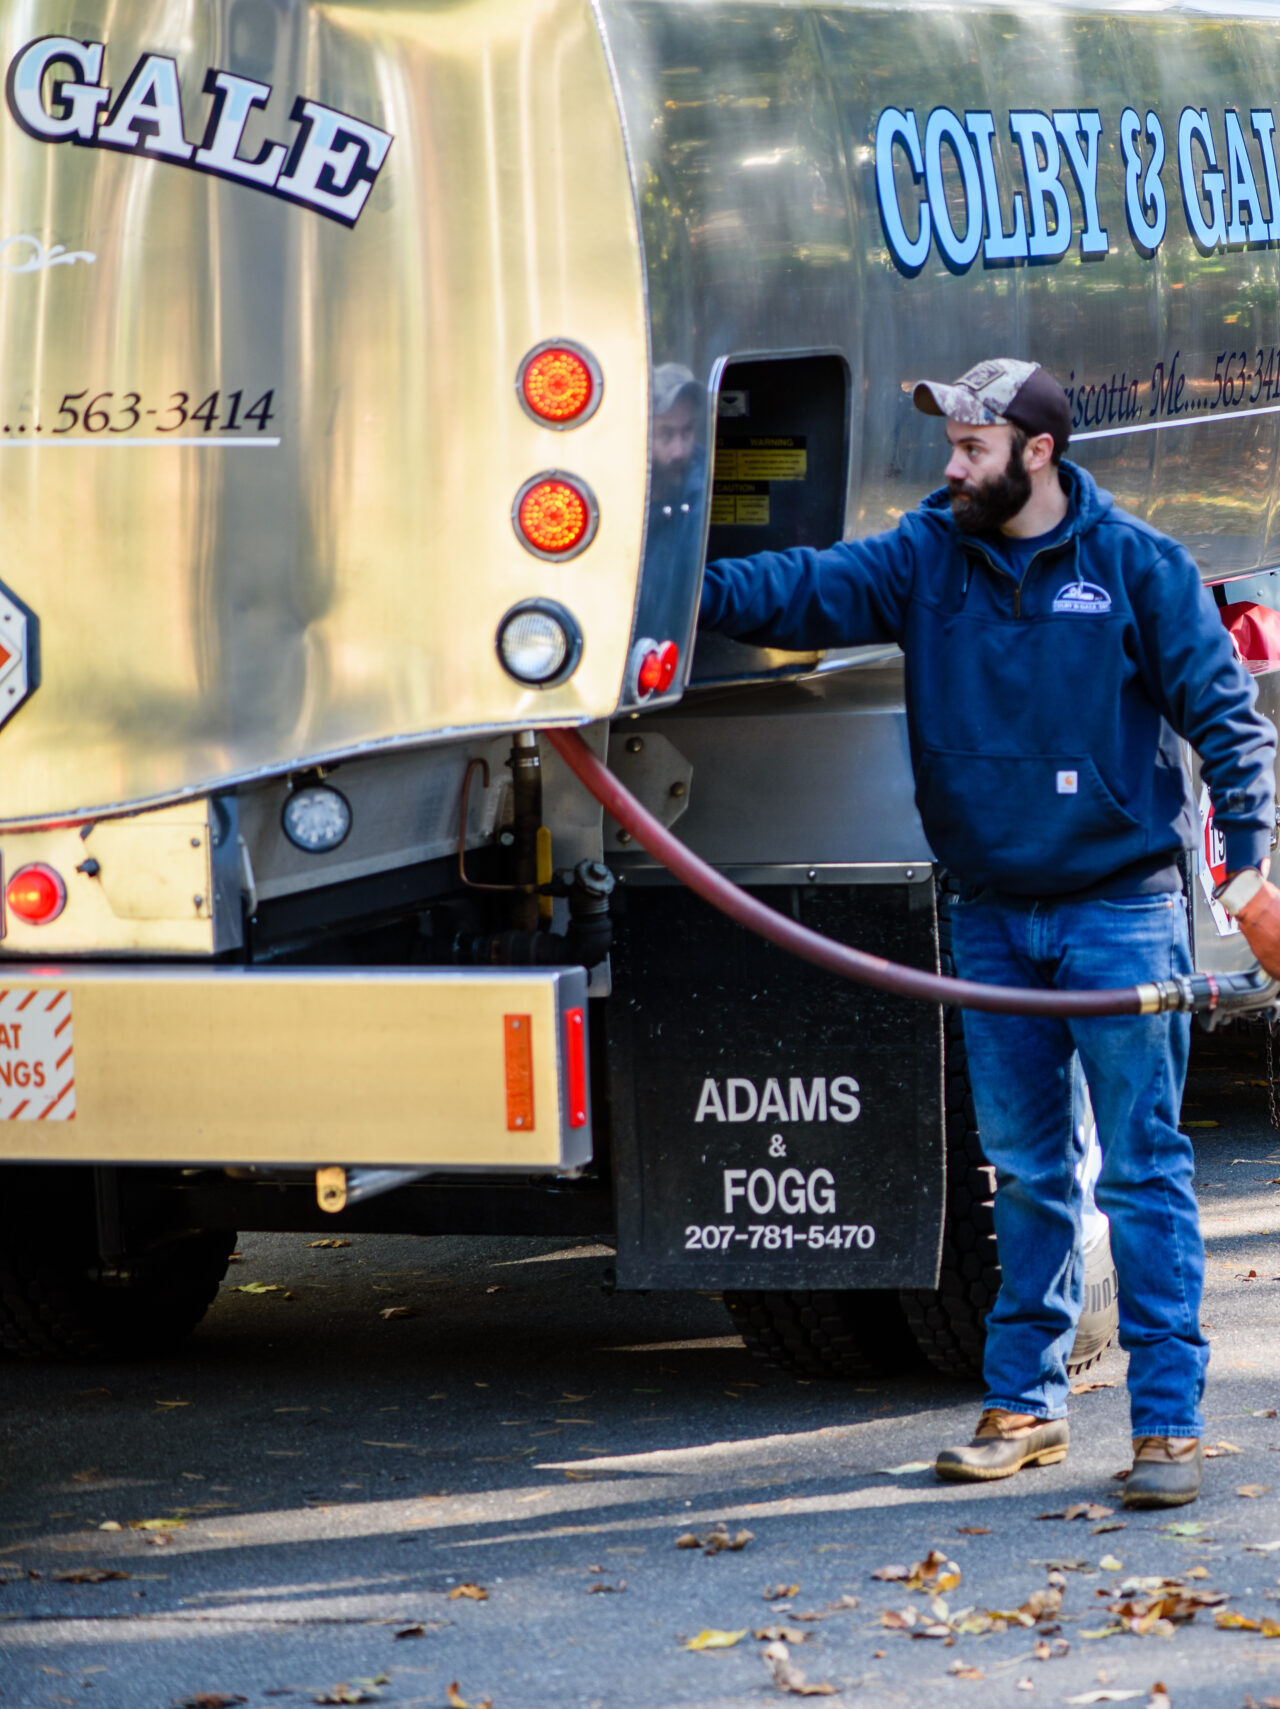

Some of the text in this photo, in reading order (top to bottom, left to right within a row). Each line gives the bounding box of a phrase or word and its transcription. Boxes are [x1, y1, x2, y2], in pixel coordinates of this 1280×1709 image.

[5, 33, 394, 229] GALE
[875, 106, 1109, 277] COLBY
[1119, 106, 1167, 259] &
[694, 1076, 861, 1122] ADAMS
[768, 1133, 787, 1158] &
[723, 1168, 837, 1215] FOGG
[684, 1224, 876, 1250] 207-781-5470
